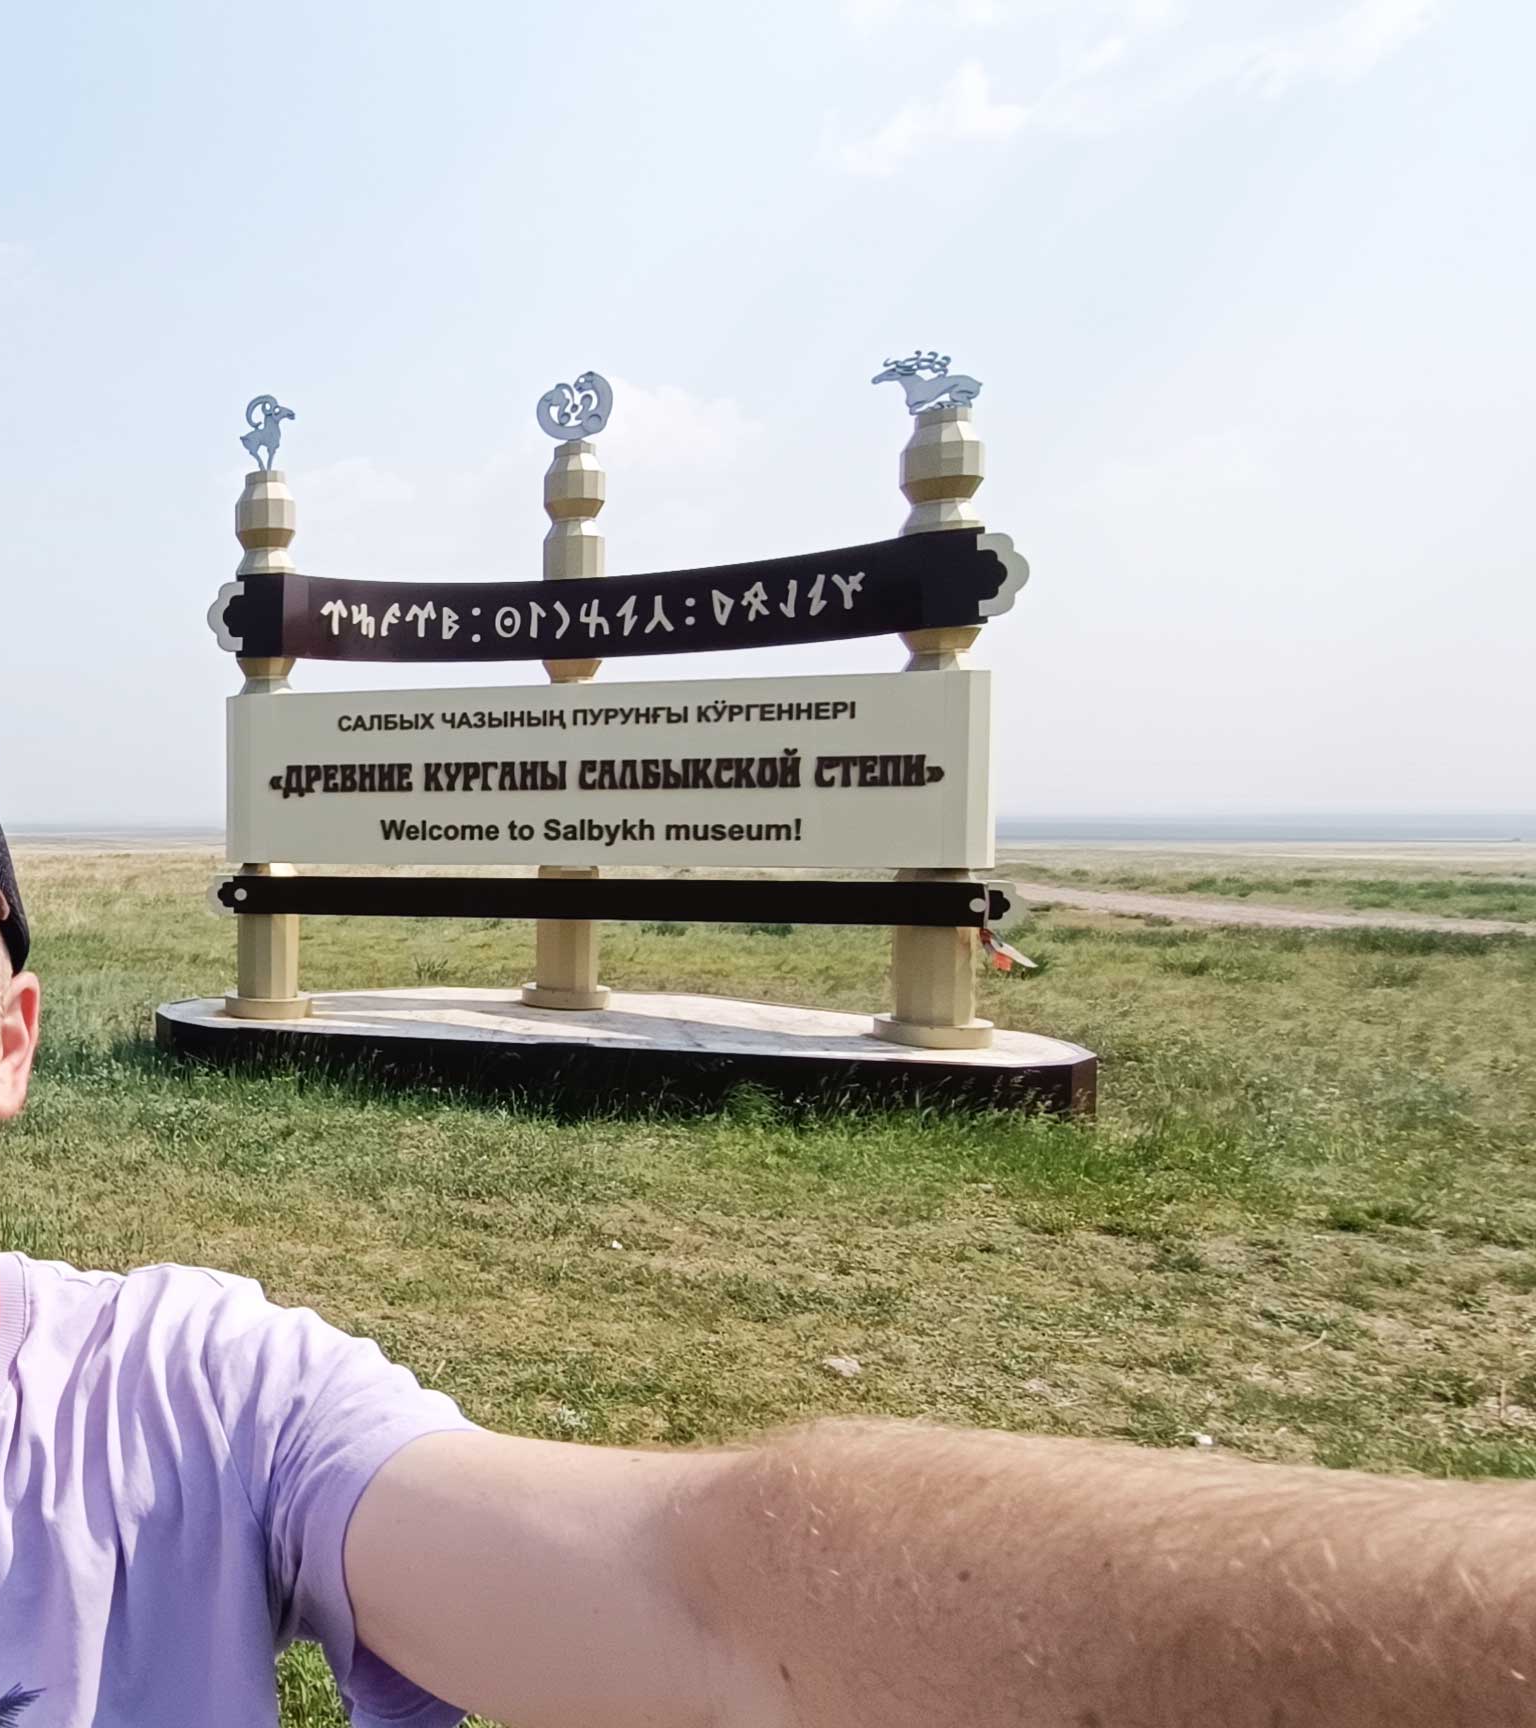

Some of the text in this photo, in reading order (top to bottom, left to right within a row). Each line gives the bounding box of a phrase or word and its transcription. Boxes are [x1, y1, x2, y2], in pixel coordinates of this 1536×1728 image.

[337, 712, 435, 732] САЛБЫХ
[440, 709, 568, 730] ЧАЗЫНЫҢ
[572, 705, 689, 727] ПУРУНҒЫ
[268, 747, 946, 799] «ДРЕВНИЕ КУРГАНЫ САЛБЫКСКОЙ СТЕПИ»
[379, 817, 802, 847] Welcome to Salbykh museum!
